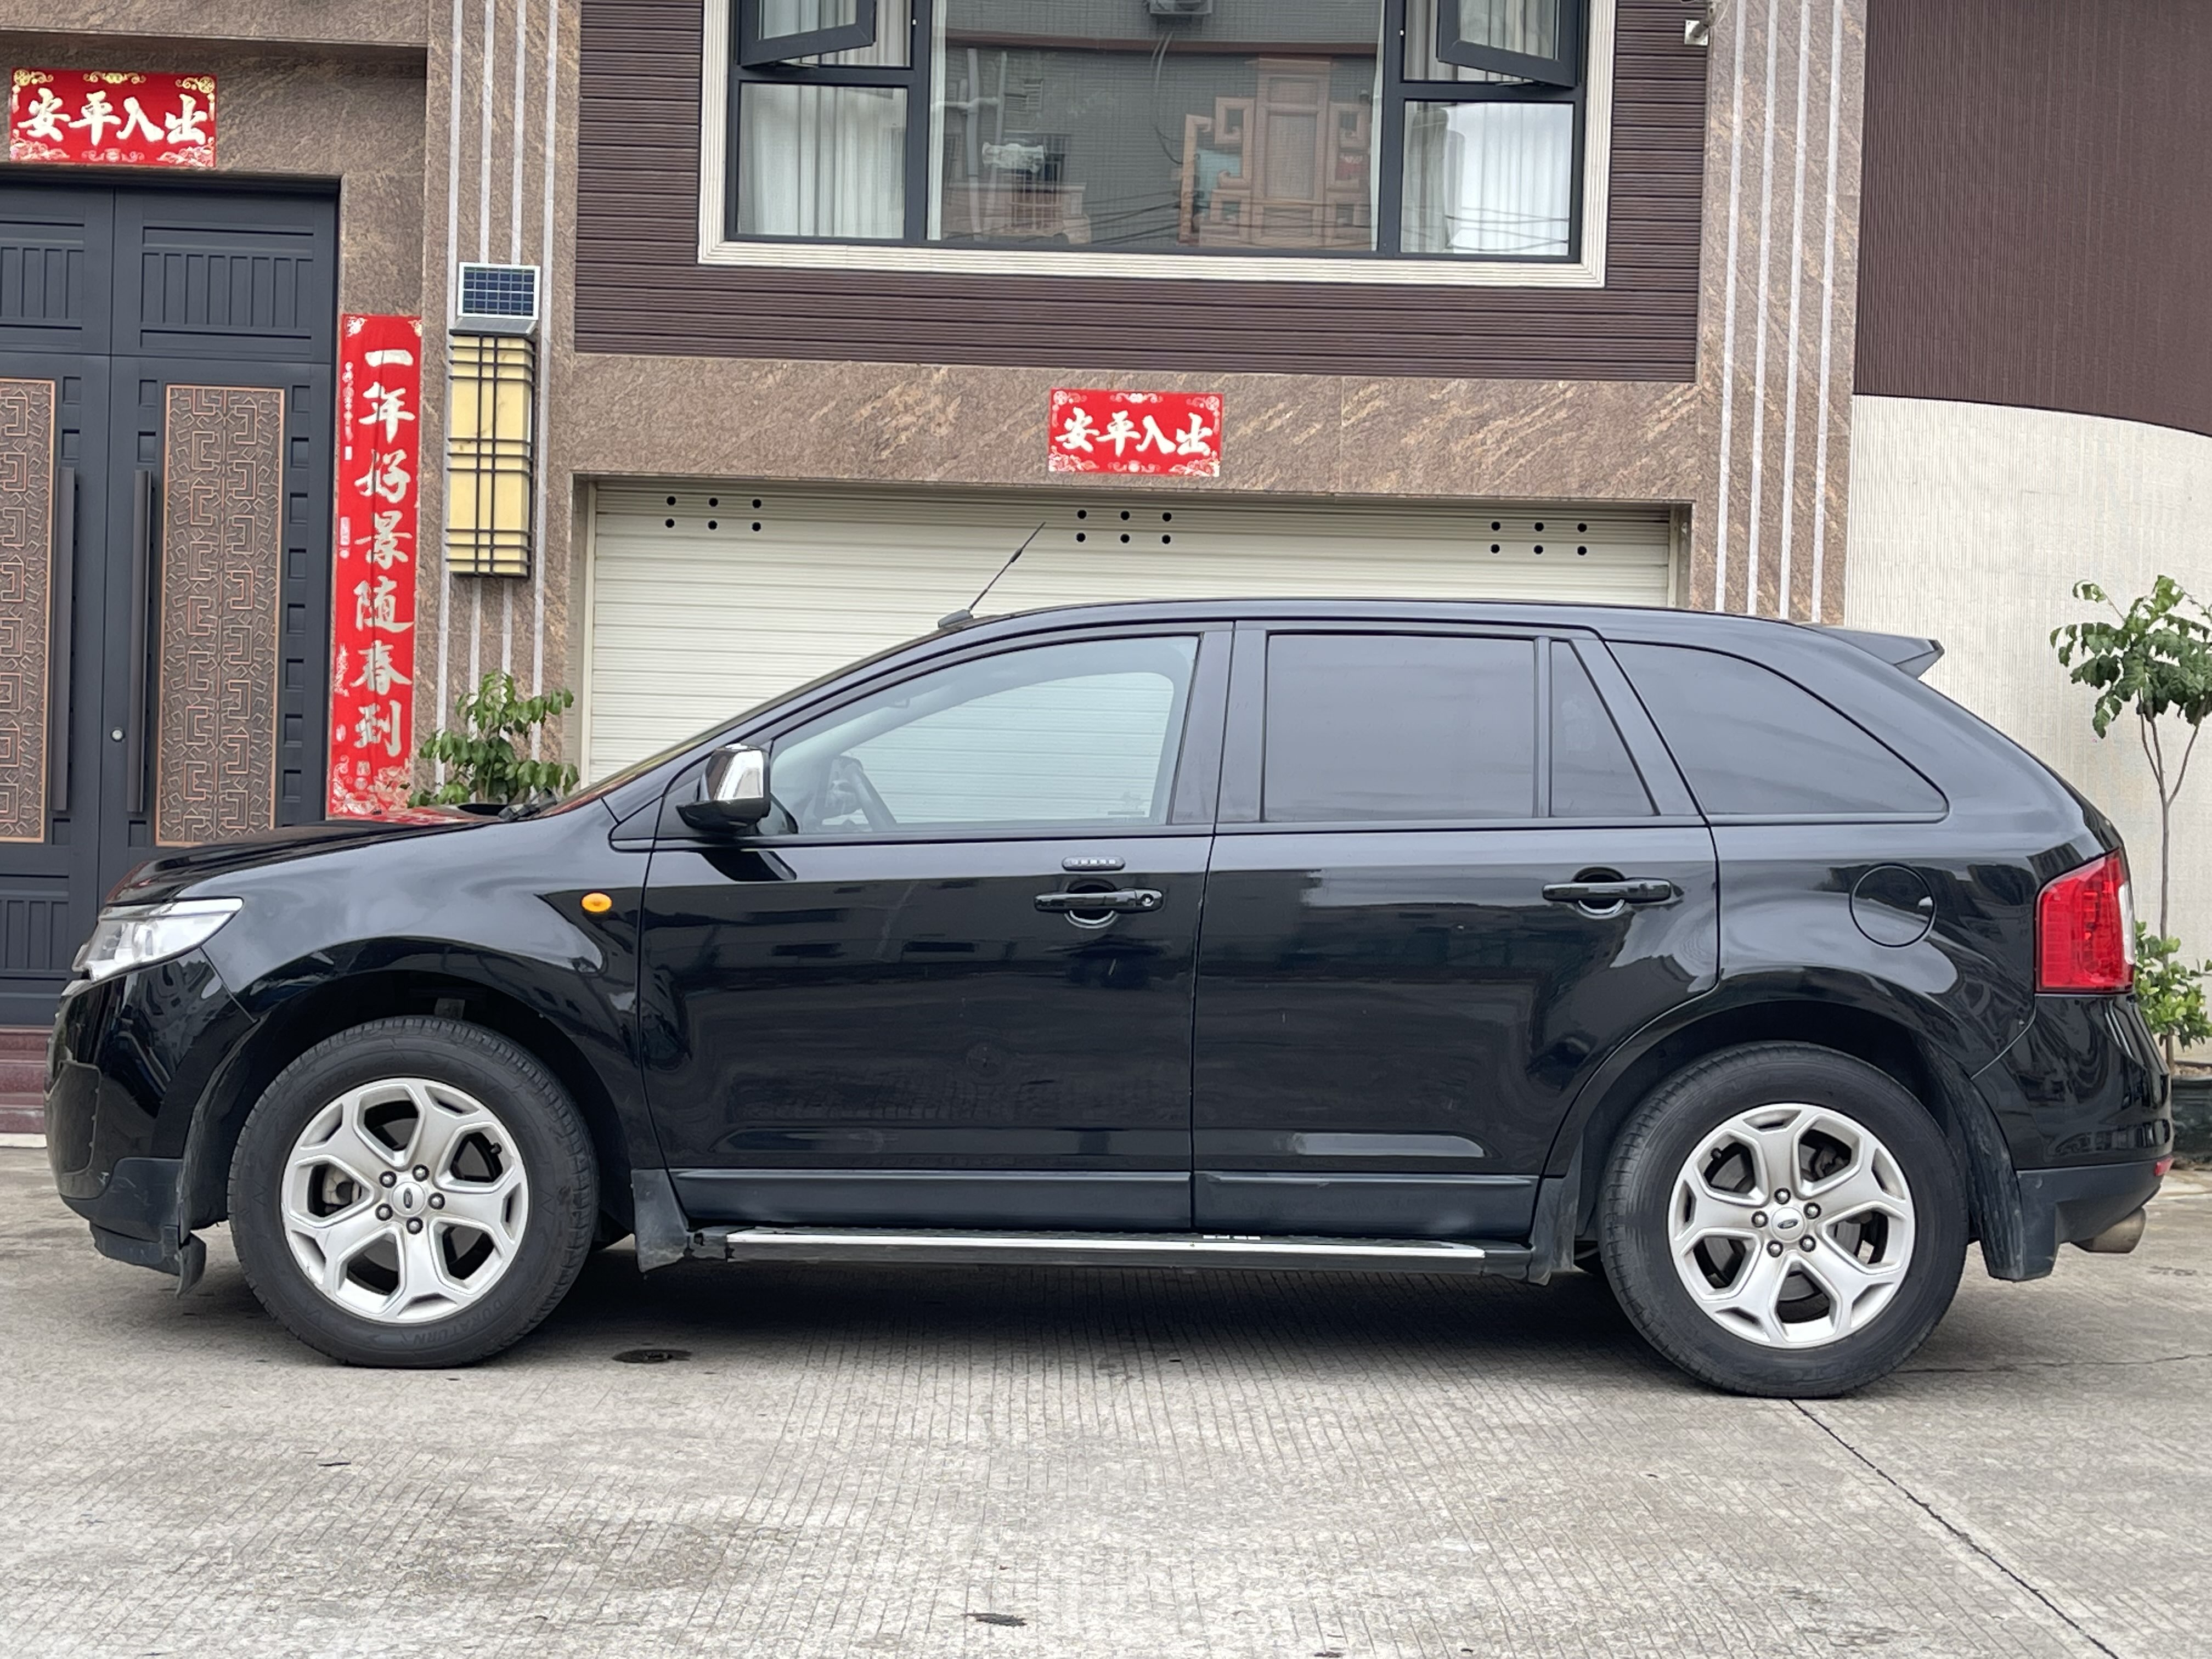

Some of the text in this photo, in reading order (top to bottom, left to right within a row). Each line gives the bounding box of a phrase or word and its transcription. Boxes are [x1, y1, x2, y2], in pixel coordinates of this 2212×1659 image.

[350, 349, 415, 758] 一年好景随春到
